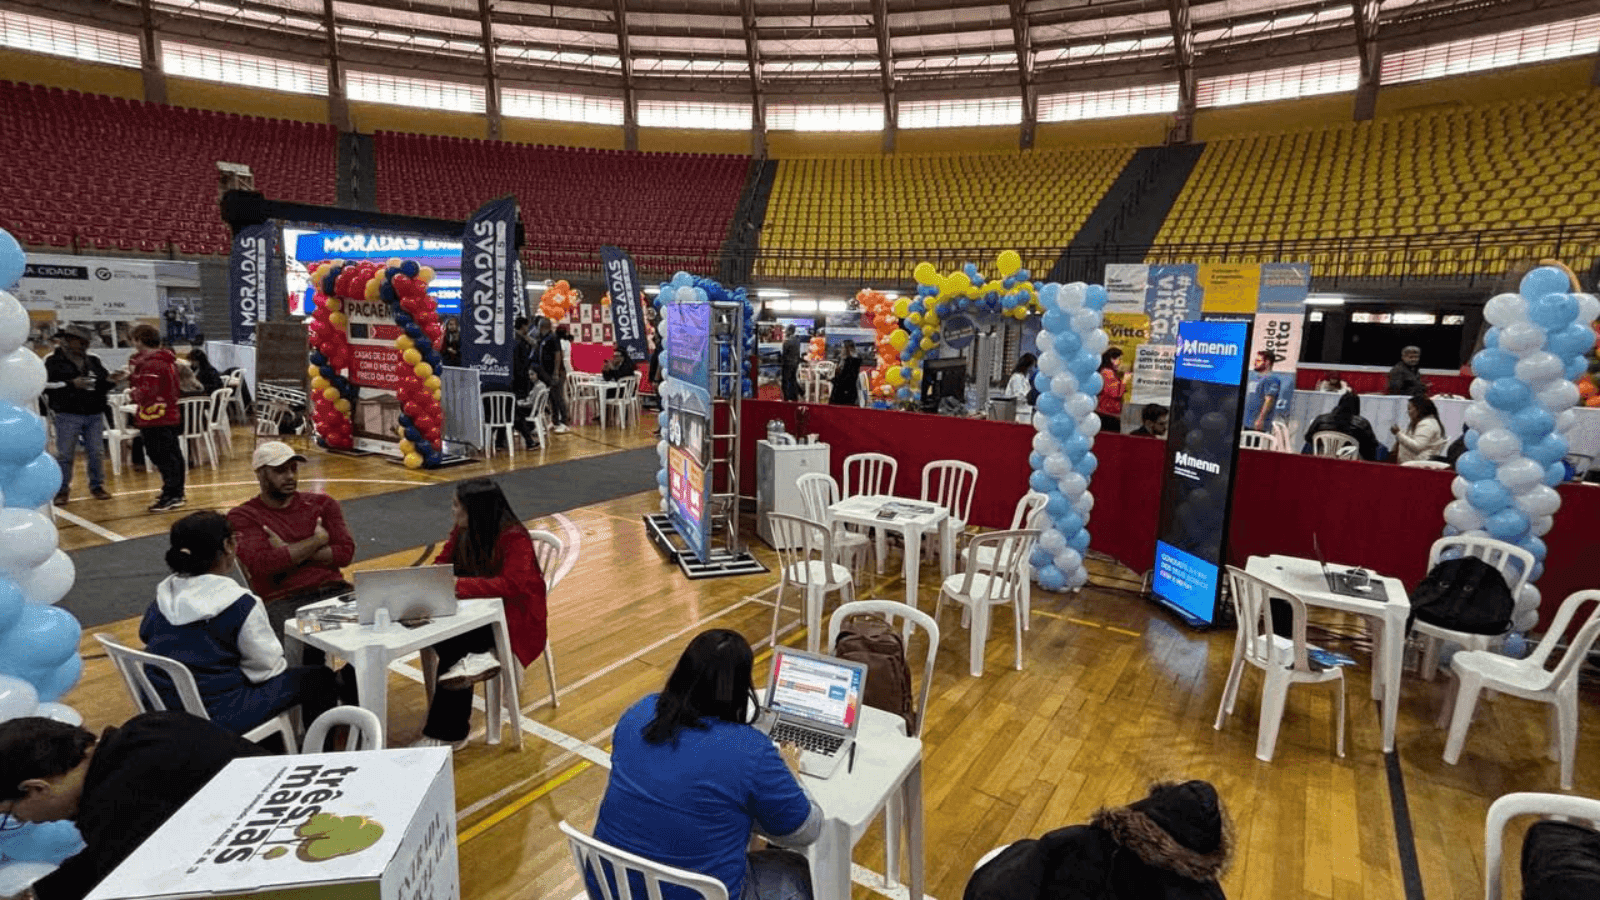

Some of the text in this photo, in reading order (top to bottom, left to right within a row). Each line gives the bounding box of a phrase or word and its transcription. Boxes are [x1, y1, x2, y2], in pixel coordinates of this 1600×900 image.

[37, 267, 79, 277] CIDADE
[323, 235, 420, 253] MORADAS
[240, 236, 257, 326] MORADAS
[473, 219, 494, 345] MORADAS
[608, 260, 633, 341] MORADAS
[1152, 275, 1175, 334] vitta
[1263, 320, 1277, 352] aide
[1273, 321, 1290, 363] vitta
[213, 764, 325, 865] marias
[288, 765, 358, 821] três
